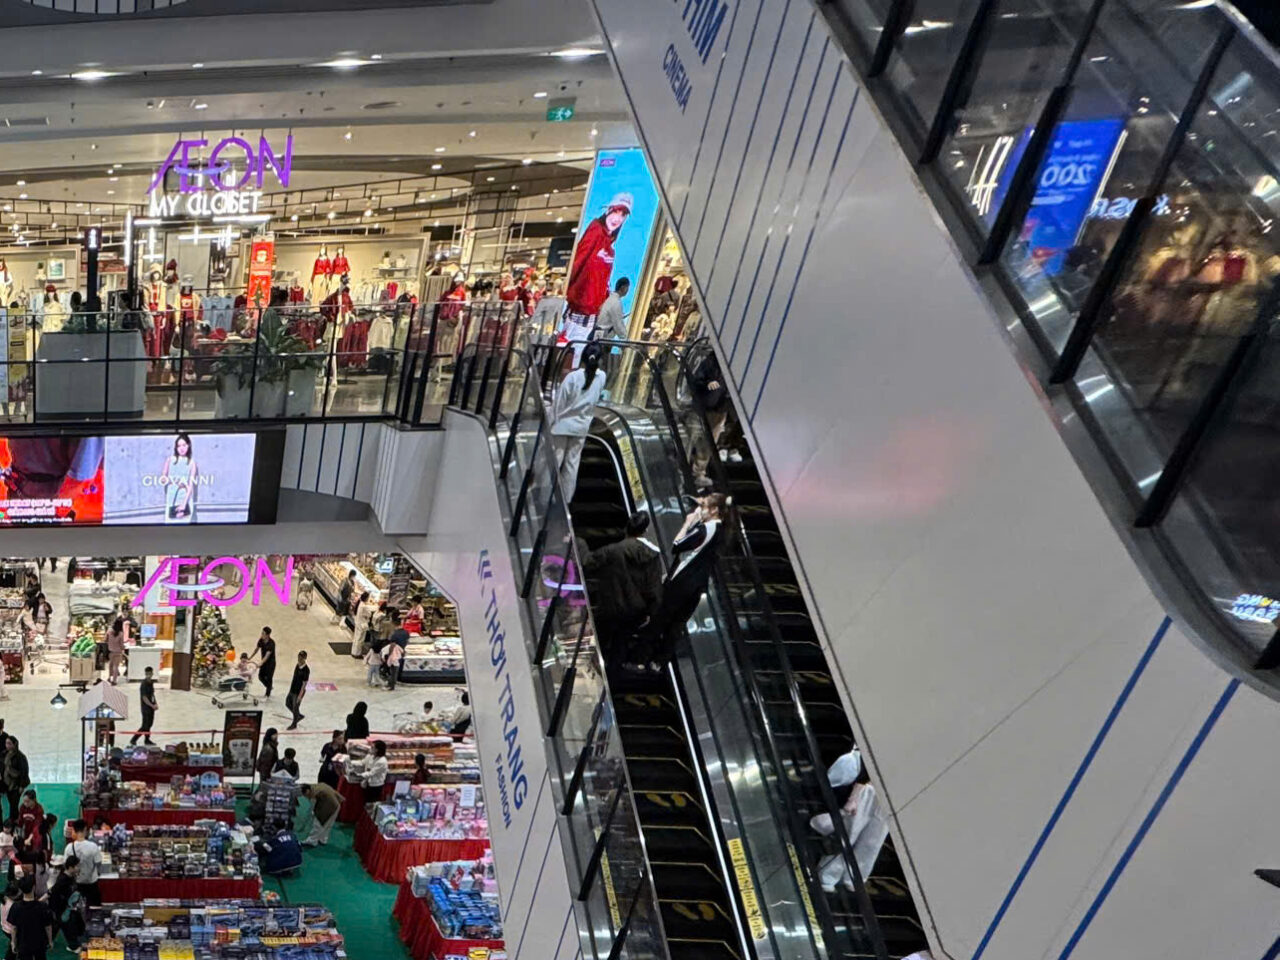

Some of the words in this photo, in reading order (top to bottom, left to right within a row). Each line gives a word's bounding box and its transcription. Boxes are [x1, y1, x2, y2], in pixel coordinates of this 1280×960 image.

[663, 43, 693, 115] CINEMA
[150, 192, 181, 217] MY
[186, 190, 264, 214] CLOSET
[141, 474, 215, 488] GIOVANNI
[497, 674, 529, 811] TRANG
[494, 752, 513, 830] FASHION
